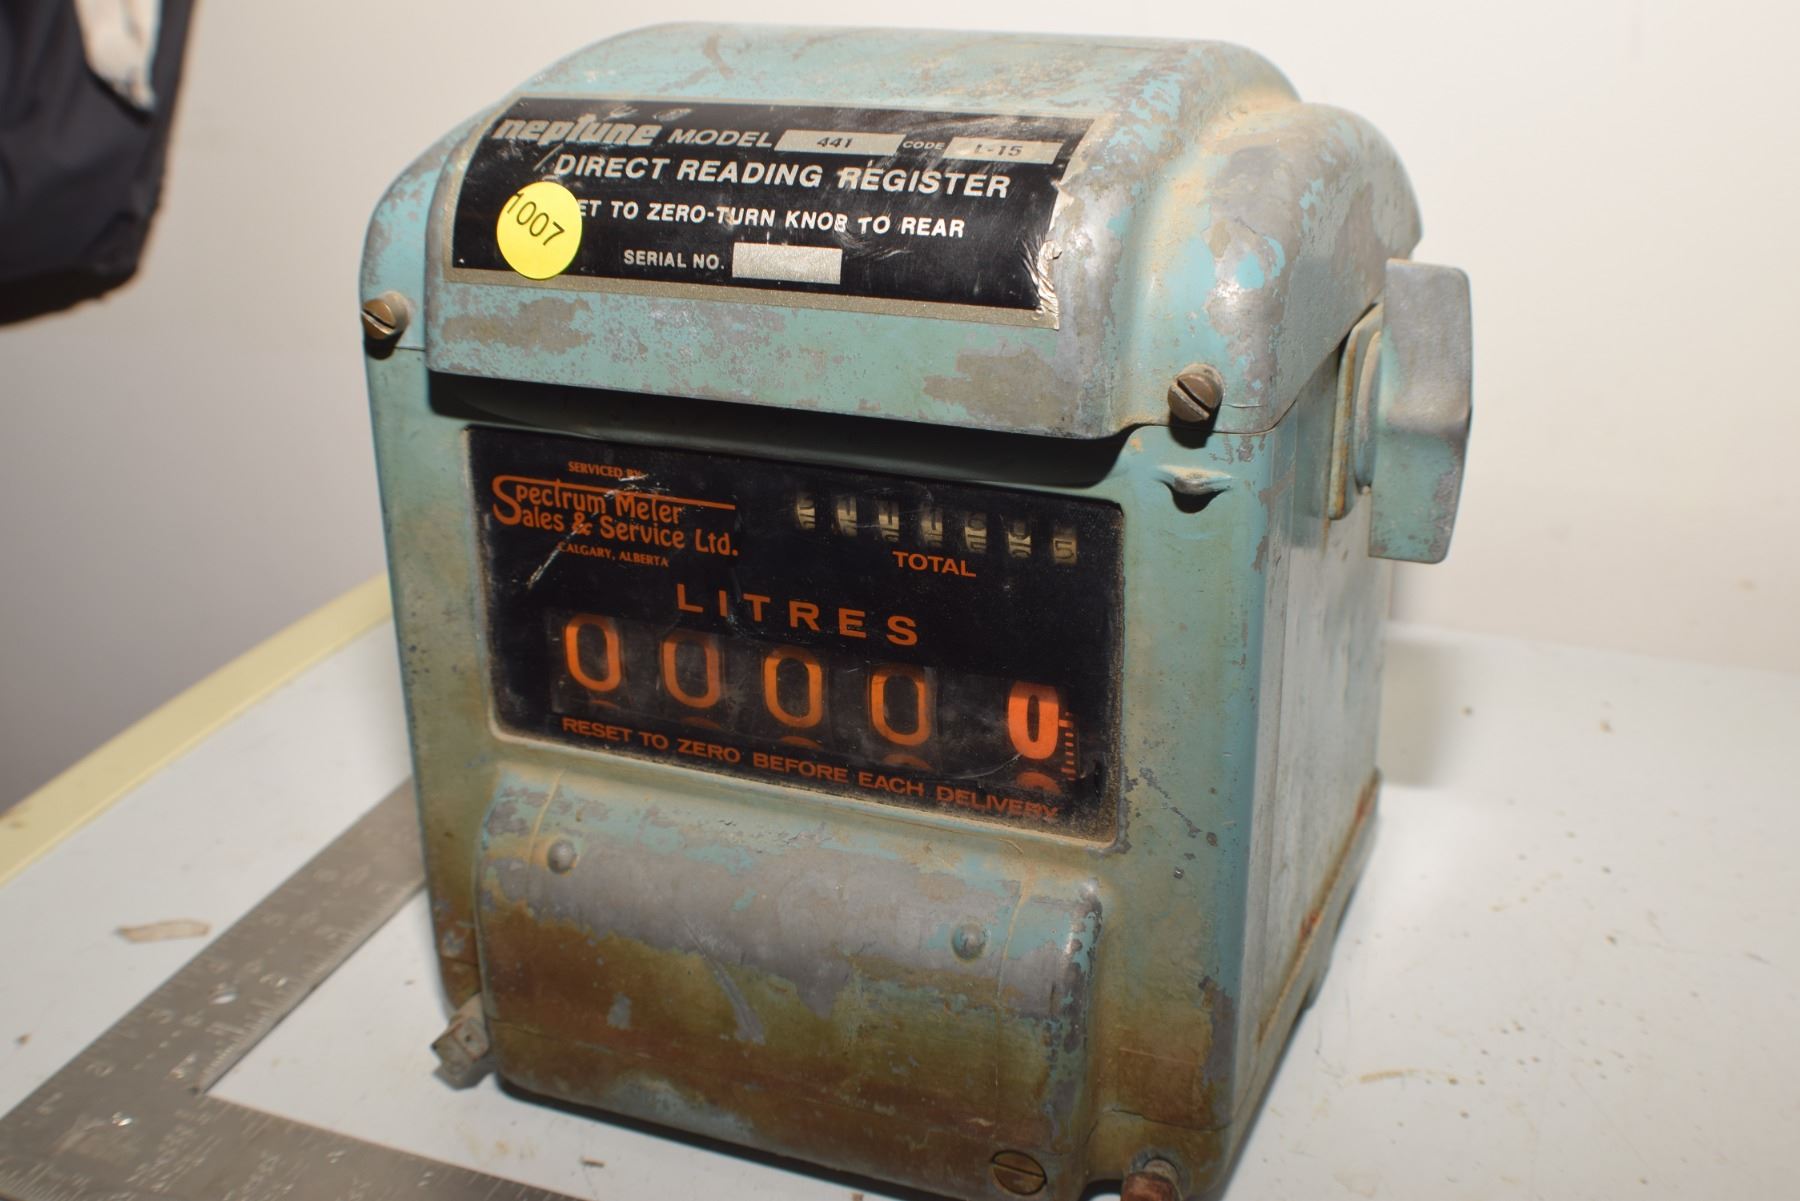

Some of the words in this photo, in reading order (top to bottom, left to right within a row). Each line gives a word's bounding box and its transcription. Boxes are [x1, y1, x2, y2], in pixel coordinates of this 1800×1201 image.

[492, 113, 663, 147] neptune
[667, 128, 773, 148] MODEL
[816, 136, 854, 149] 441
[902, 140, 946, 151] CODE
[553, 153, 671, 180] DIRECT
[676, 159, 823, 188] READING
[837, 166, 1011, 199] REGISTER
[505, 192, 566, 247] 1007
[611, 201, 639, 219] TO
[647, 203, 776, 227] ZERO-TURN
[785, 211, 848, 232] KNOB
[857, 216, 891, 234] TO
[901, 218, 965, 239] REAR
[623, 249, 688, 268] SERIAL
[692, 253, 725, 270] NO.
[568, 460, 624, 478] SERVICED
[492, 475, 606, 526] Spectrum
[616, 491, 684, 524] Meter
[573, 512, 594, 536] &
[600, 518, 686, 549] Service
[695, 529, 738, 557] Ltd.
[619, 551, 669, 567] ALBERTA
[892, 551, 977, 578] TOTAL
[677, 584, 919, 646] LITRES
[562, 717, 633, 743] RESET
[639, 732, 669, 750] TO
[678, 738, 741, 763] ZERO
[753, 751, 848, 784] BEFORE
[858, 772, 924, 797] EACH
[936, 786, 1058, 819] DELIVERY
